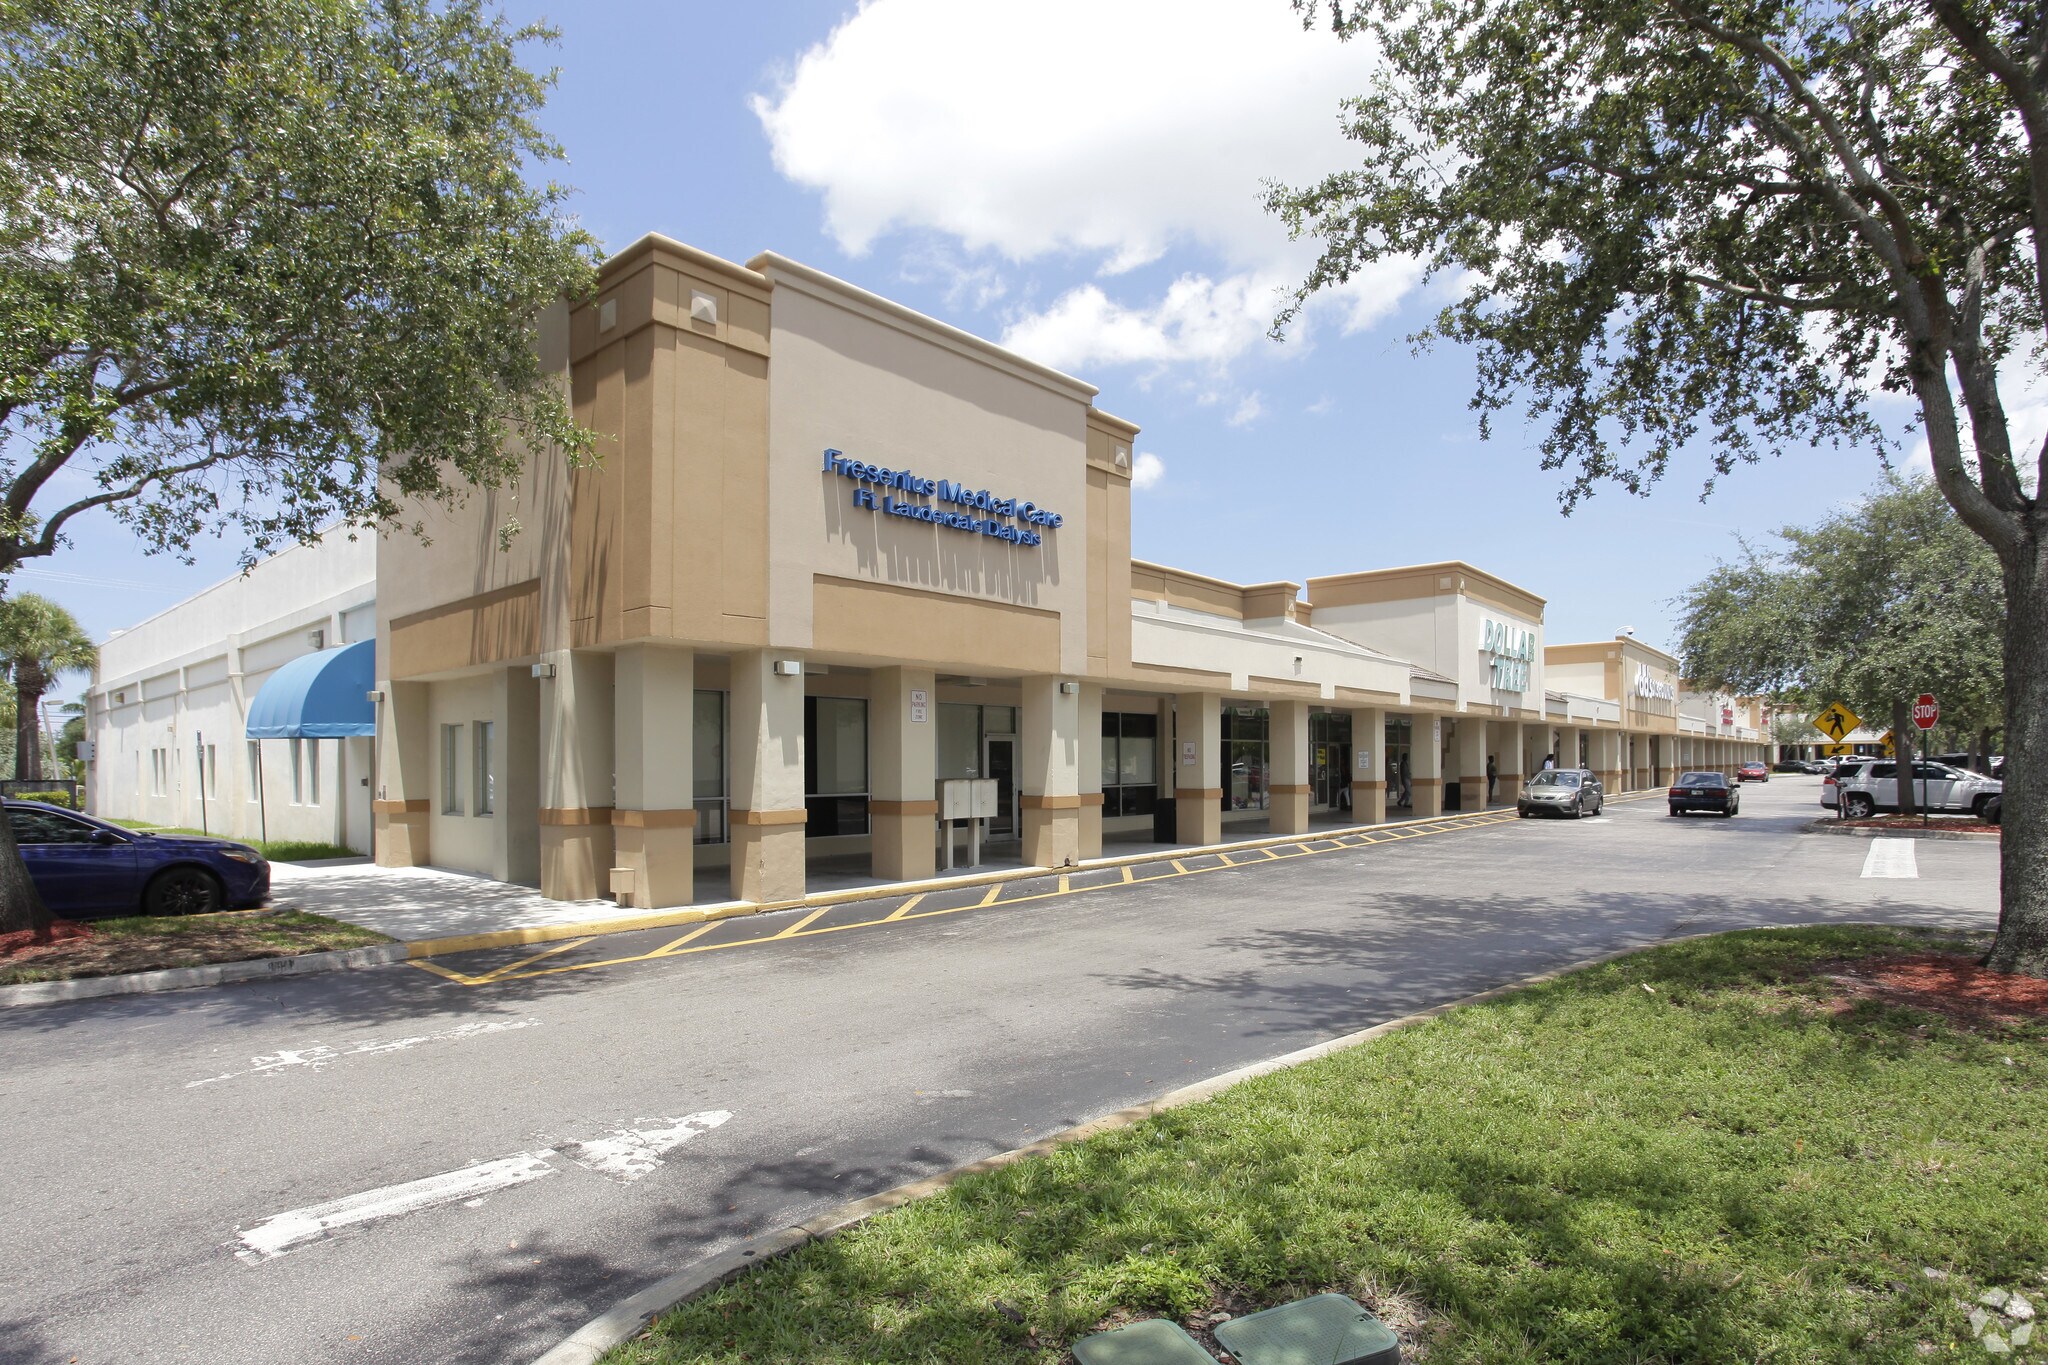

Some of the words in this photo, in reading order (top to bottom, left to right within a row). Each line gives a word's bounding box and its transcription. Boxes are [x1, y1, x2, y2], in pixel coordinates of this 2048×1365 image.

[822, 448, 936, 497] Fresenius
[938, 479, 1017, 518] Medical
[1017, 501, 1063, 529] Care
[883, 495, 983, 533] Lauderdale
[983, 518, 1041, 547] Dialysis
[1480, 618, 1535, 662] DOLLAR
[1491, 656, 1528, 693] TREE
[1914, 705, 1937, 718] STOP
